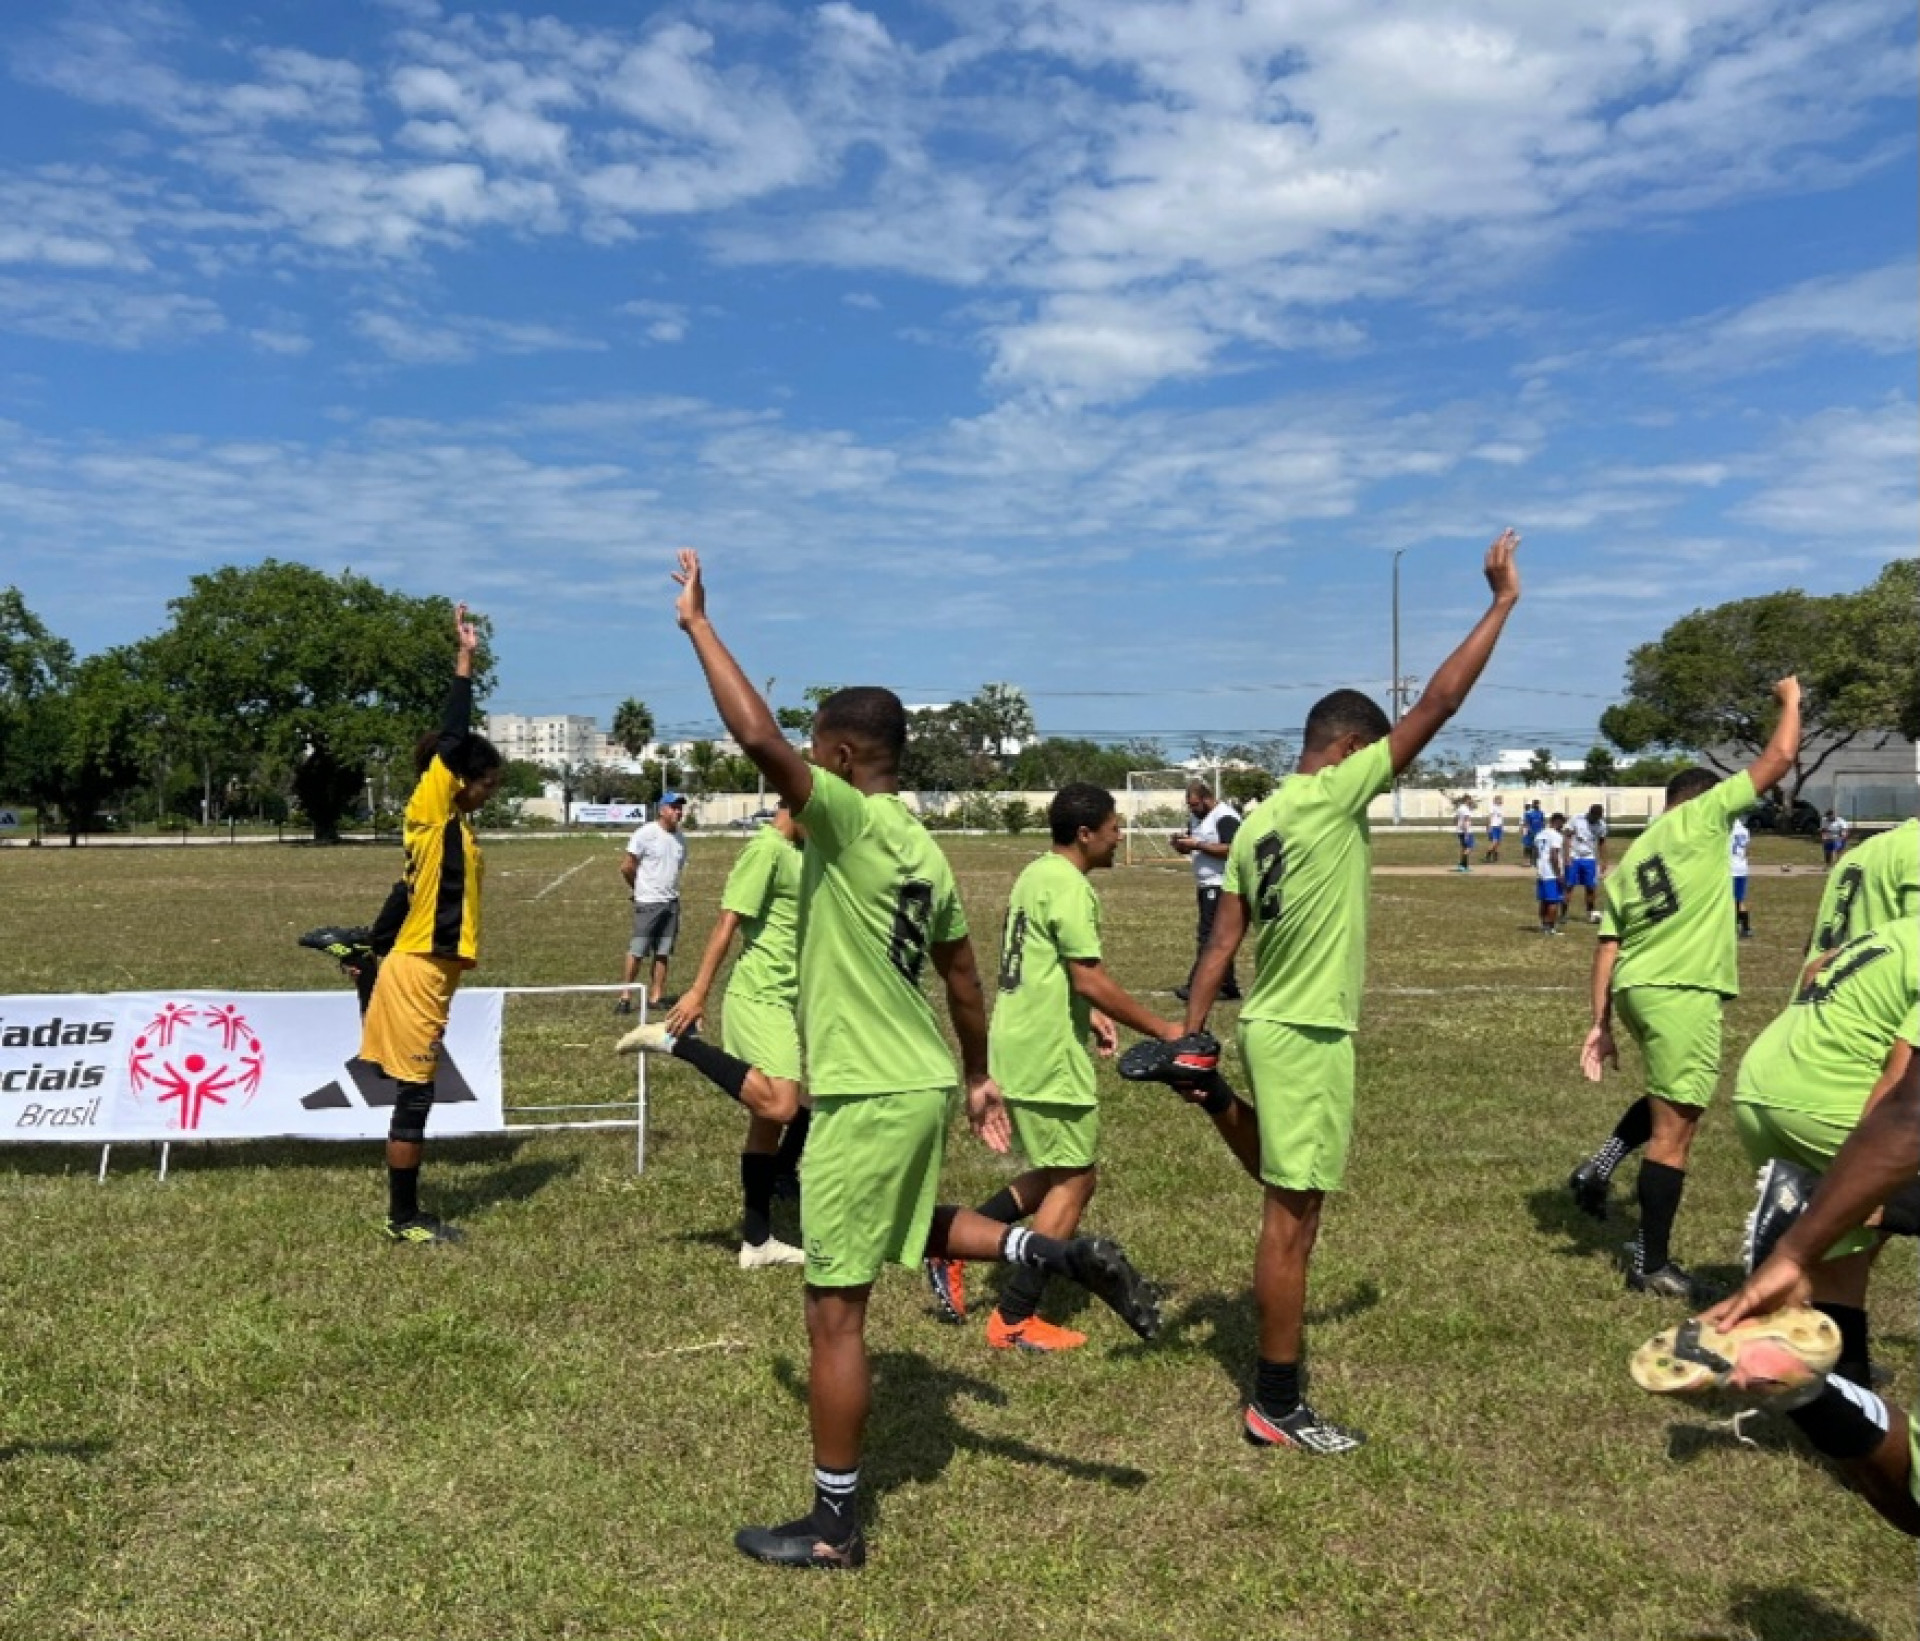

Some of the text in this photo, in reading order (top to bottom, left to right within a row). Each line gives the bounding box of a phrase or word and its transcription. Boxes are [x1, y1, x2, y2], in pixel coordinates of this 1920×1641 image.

[1254, 831, 1284, 921] 2
[1635, 853, 1679, 923] 9
[0, 1017, 115, 1047] adas
[0, 1060, 106, 1091] ciais
[16, 1096, 102, 1127] Brasil
